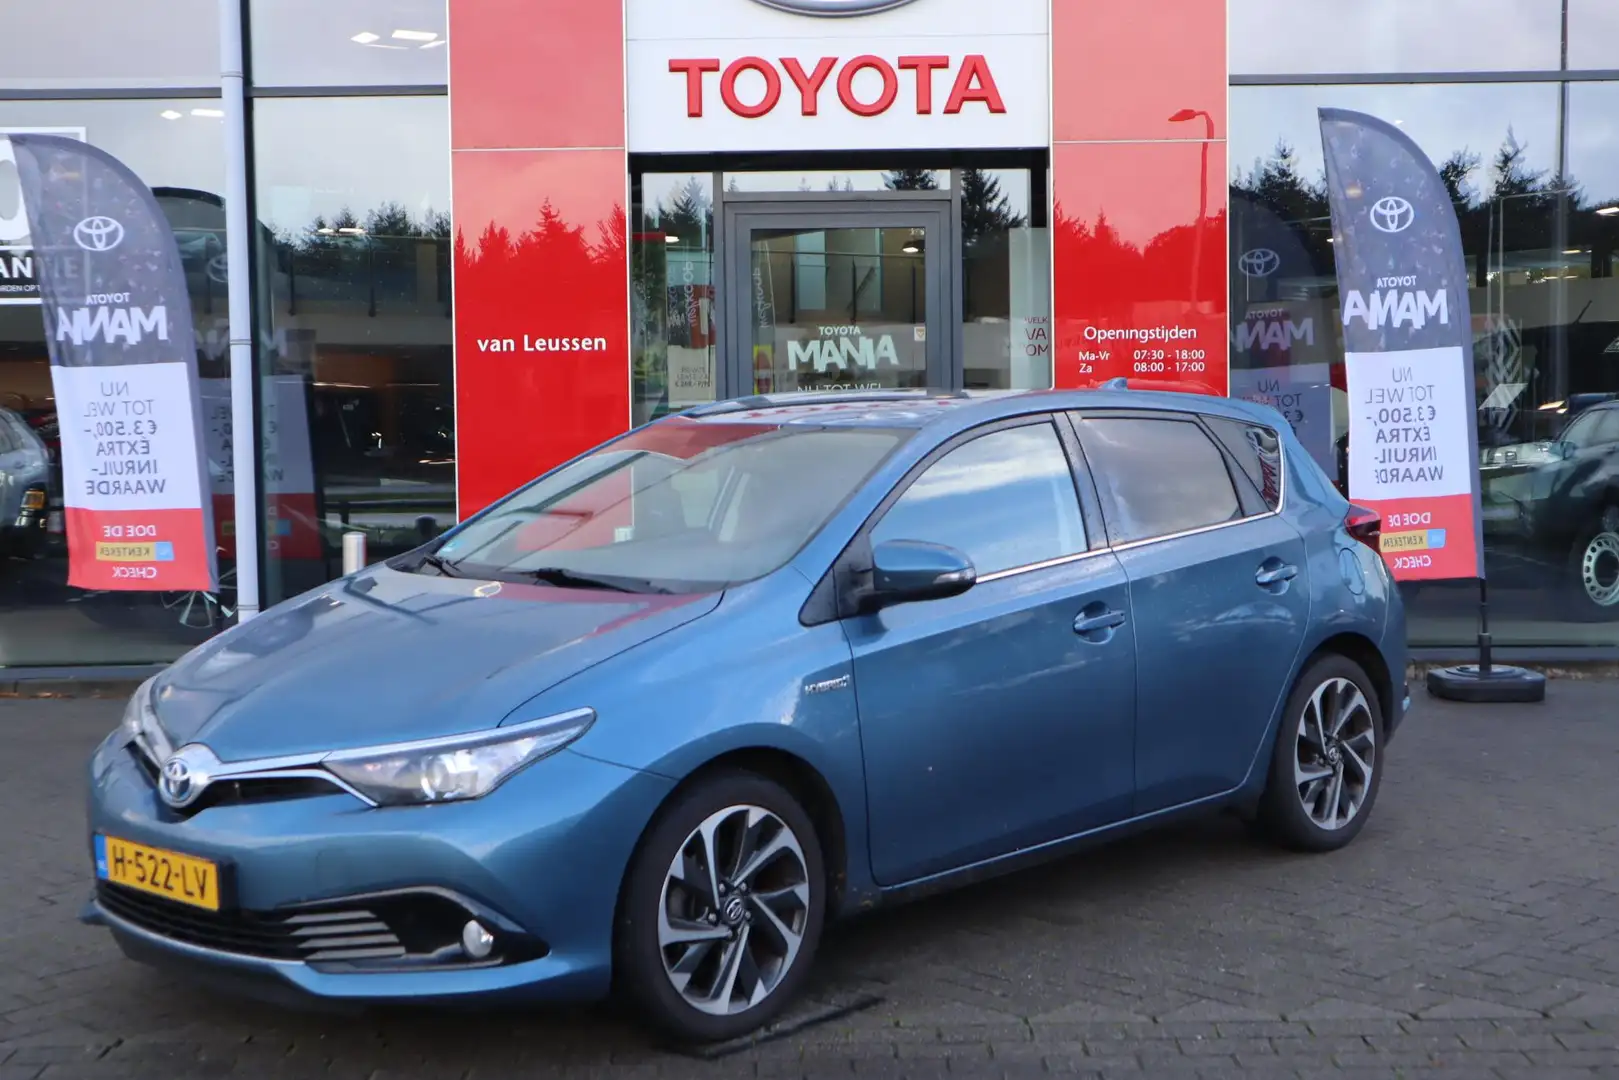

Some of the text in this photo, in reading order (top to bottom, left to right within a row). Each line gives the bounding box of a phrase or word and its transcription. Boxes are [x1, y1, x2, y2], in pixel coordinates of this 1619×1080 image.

[668, 54, 1007, 119] TOYOTA
[818, 325, 861, 336] TOYOTA
[1083, 325, 1197, 343] Openingstijden
[477, 334, 607, 352] van Leussen
[787, 334, 899, 372] MANIA
[1078, 351, 1111, 361] Ma-Vr
[1133, 349, 1164, 360] 07:30
[1175, 349, 1205, 360] 18:00
[1079, 362, 1093, 373] Za
[1133, 361, 1164, 372] 08:00
[1175, 361, 1205, 372] 17:00
[111, 844, 208, 900] H-522-LV
